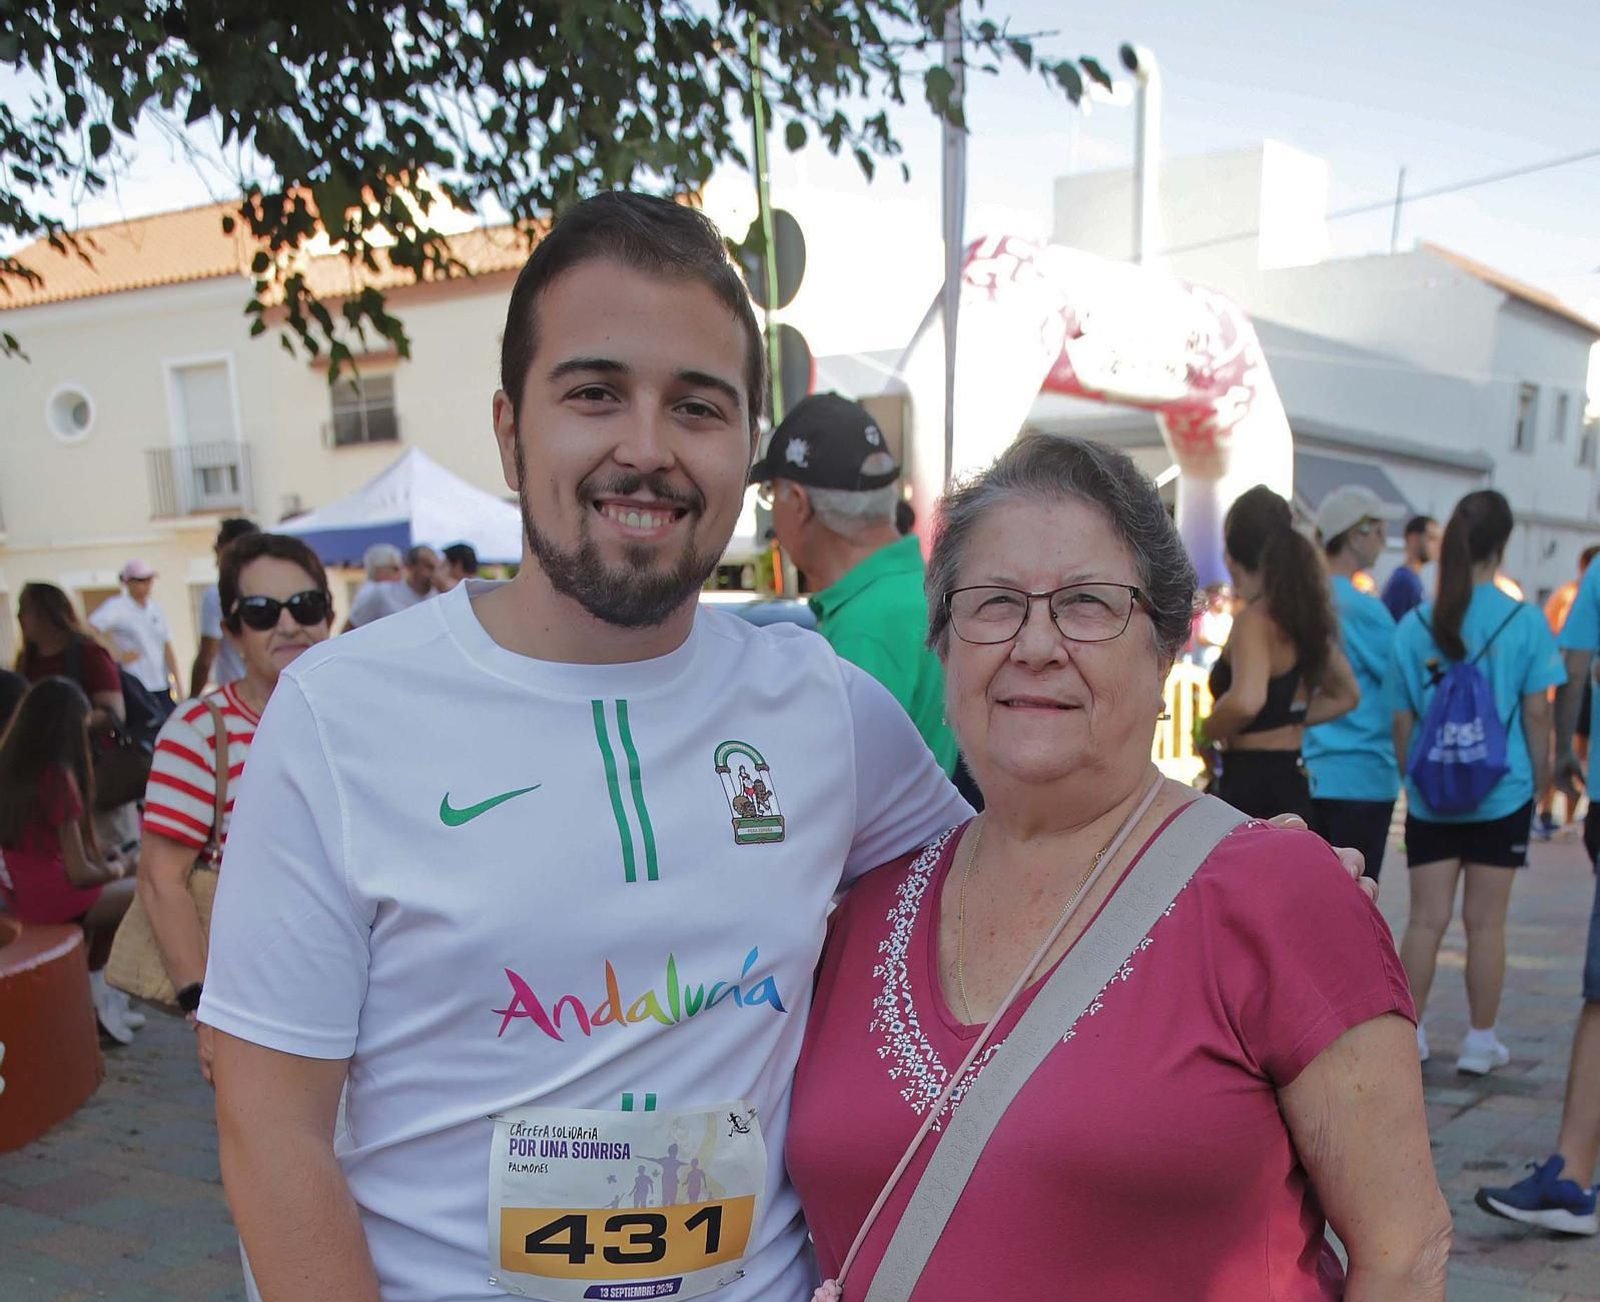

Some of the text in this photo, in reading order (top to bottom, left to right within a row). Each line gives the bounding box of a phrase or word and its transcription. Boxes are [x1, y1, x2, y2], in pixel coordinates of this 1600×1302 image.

[509, 1138, 631, 1160] POR UNA SONRISA
[524, 1204, 723, 1265] 431
[600, 1287, 609, 1298] 13
[609, 1285, 655, 1298] SEPTIEMBRE
